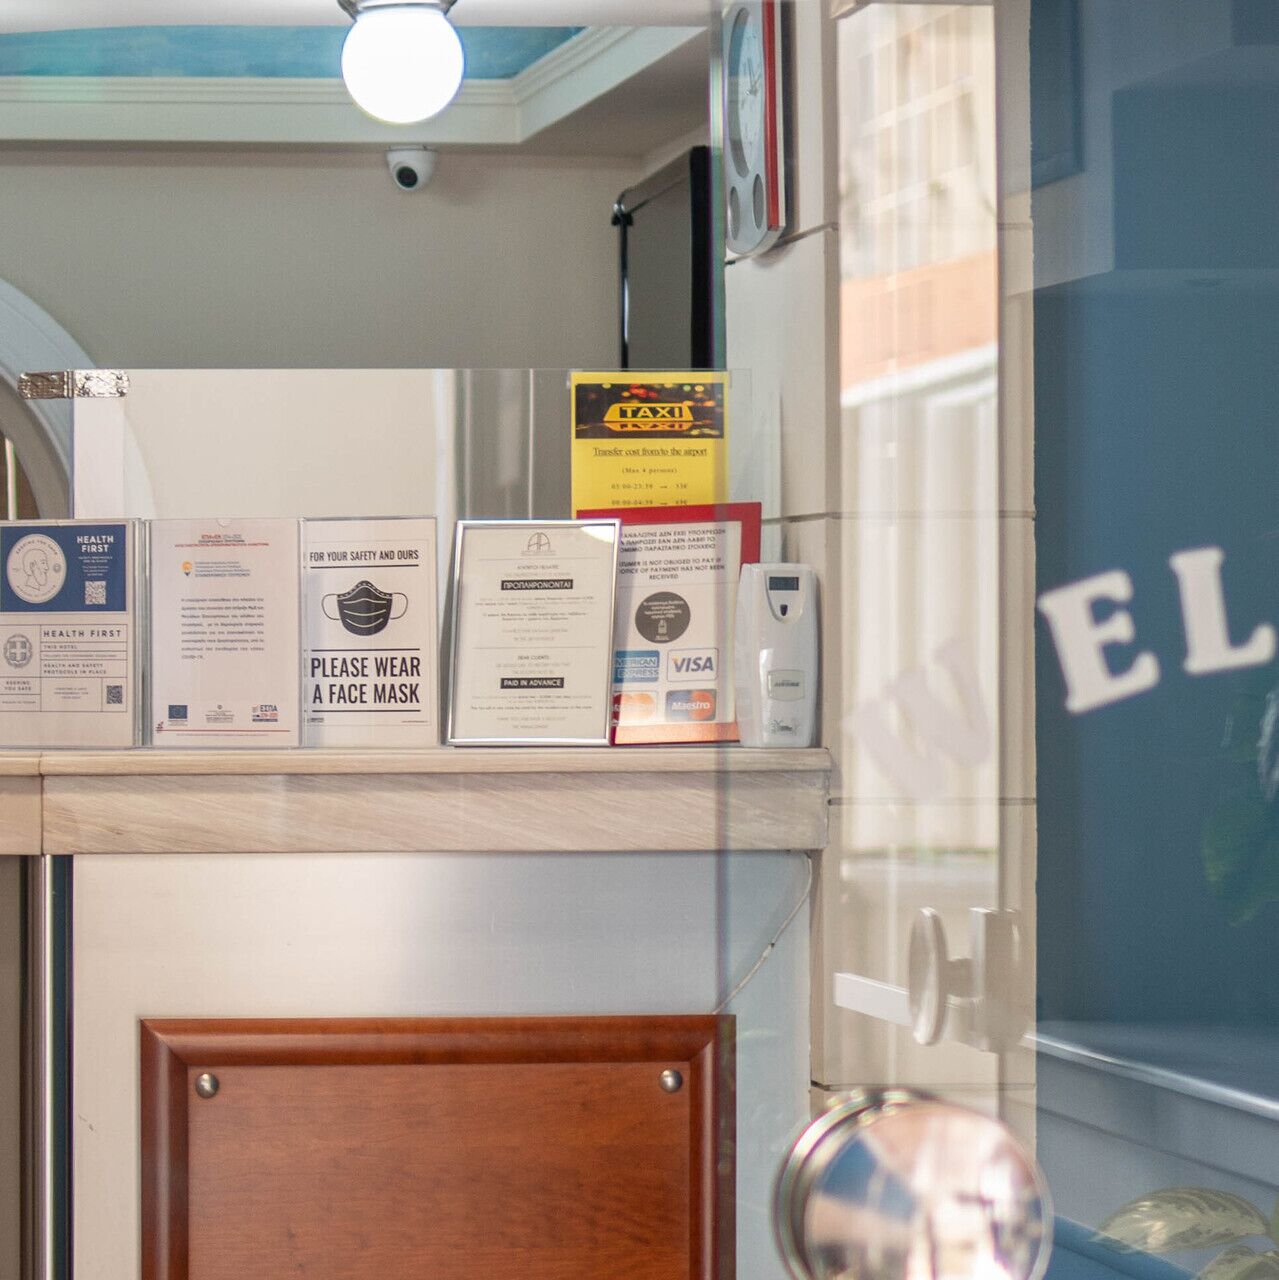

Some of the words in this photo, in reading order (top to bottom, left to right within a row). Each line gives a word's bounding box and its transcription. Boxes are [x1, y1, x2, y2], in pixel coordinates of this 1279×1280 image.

[622, 407, 680, 418] TAXI
[76, 535, 114, 544] HEALTH
[81, 544, 110, 553] FIRST
[309, 551, 325, 562] FOR
[327, 551, 348, 562] YOUR
[350, 550, 377, 562] SAFETY
[379, 549, 395, 561] AND
[397, 549, 419, 560] OURS
[43, 629, 85, 638] HEALTH
[90, 629, 121, 638] FIRST
[310, 657, 369, 678] PLEASE
[375, 656, 421, 678] WEAR
[617, 657, 657, 667] MERICAN
[673, 656, 714, 673] VISA
[503, 679, 519, 687] PAID
[529, 678, 562, 687] ADVANCE
[312, 684, 323, 704] A
[329, 684, 367, 704] FACE
[373, 683, 420, 704] MASK
[260, 704, 278, 712] ΕΣΠΑ
[671, 701, 711, 711] Maestro
